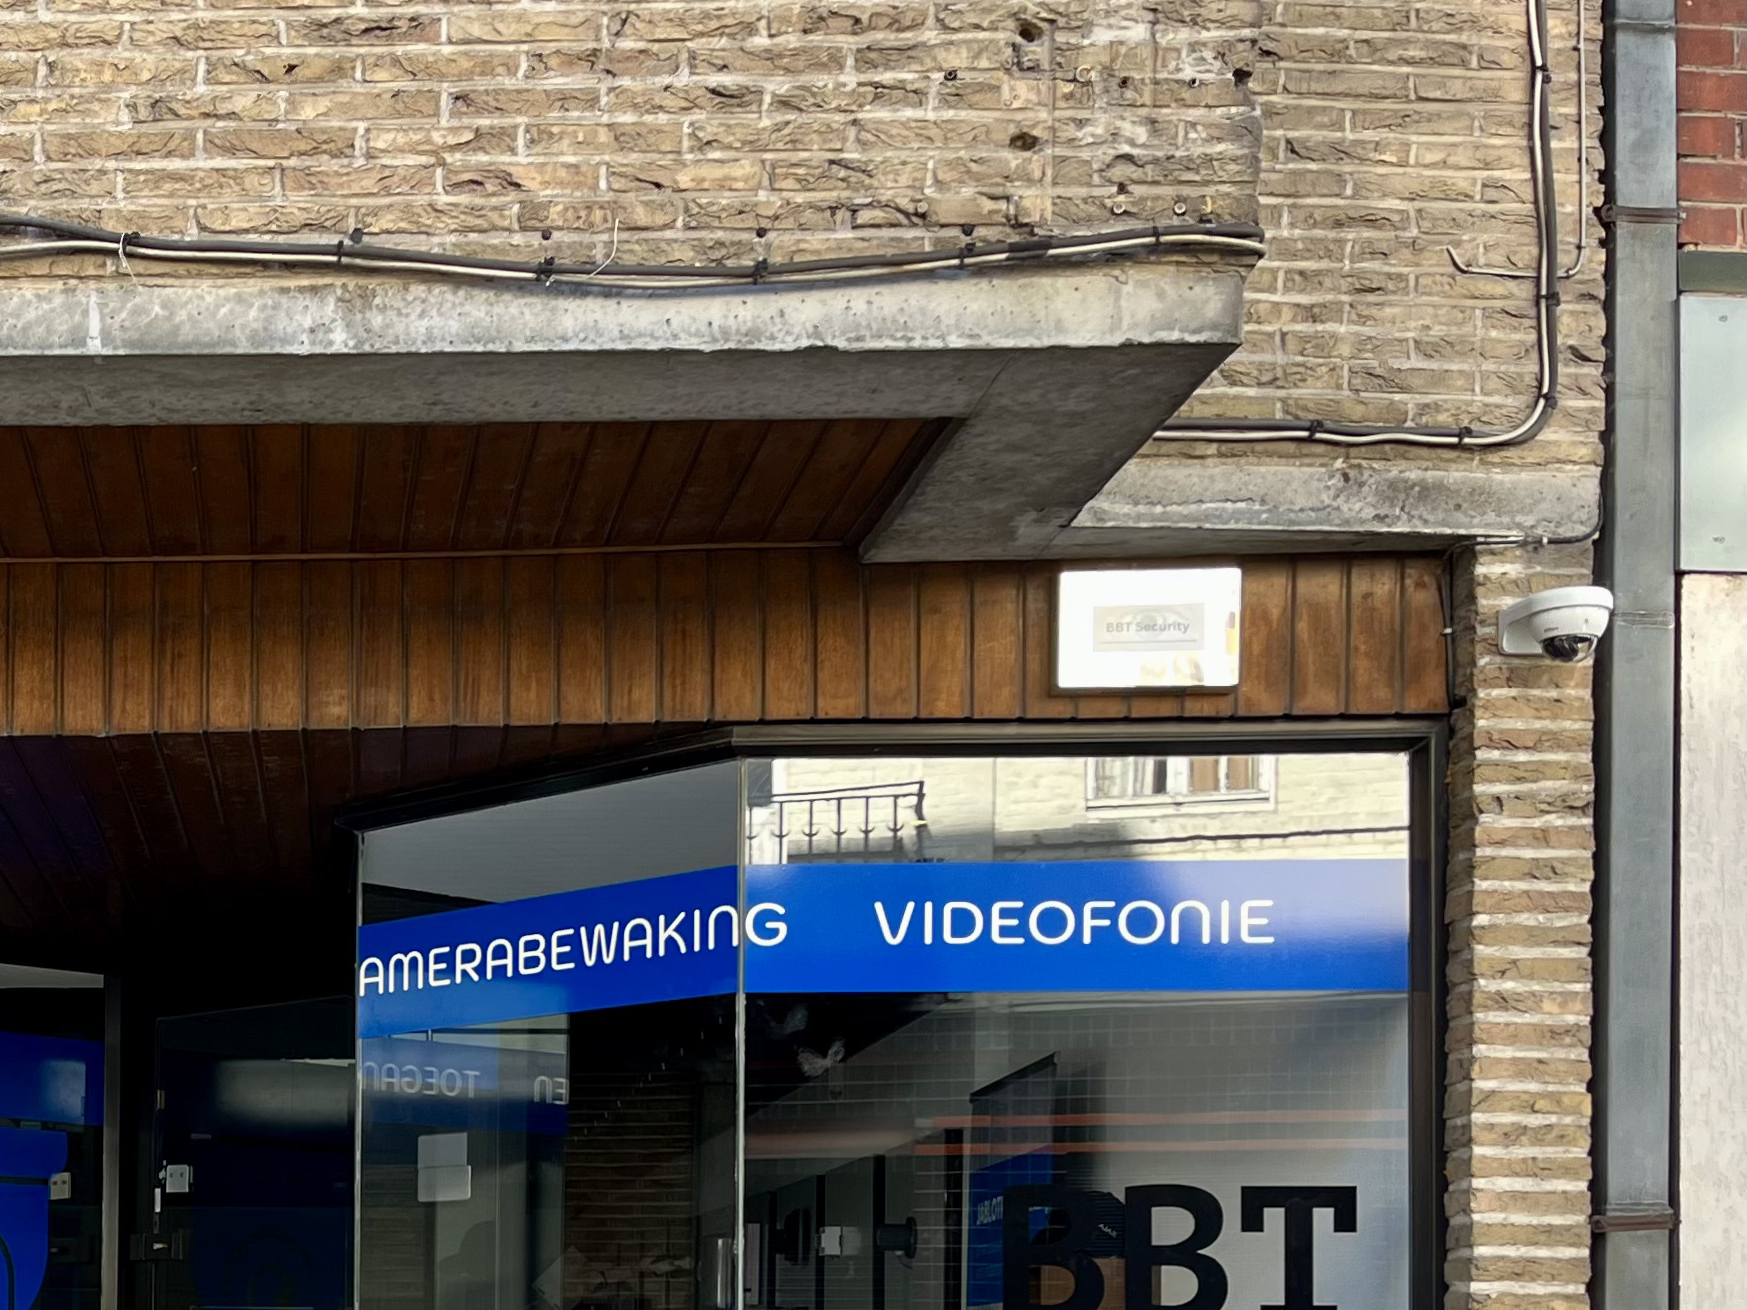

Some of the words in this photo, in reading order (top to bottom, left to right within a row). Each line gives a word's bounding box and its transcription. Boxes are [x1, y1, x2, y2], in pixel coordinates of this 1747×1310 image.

[1106, 621, 1132, 633] BBT
[1135, 620, 1190, 634] Security
[873, 898, 1276, 946] VIDEOFONIE
